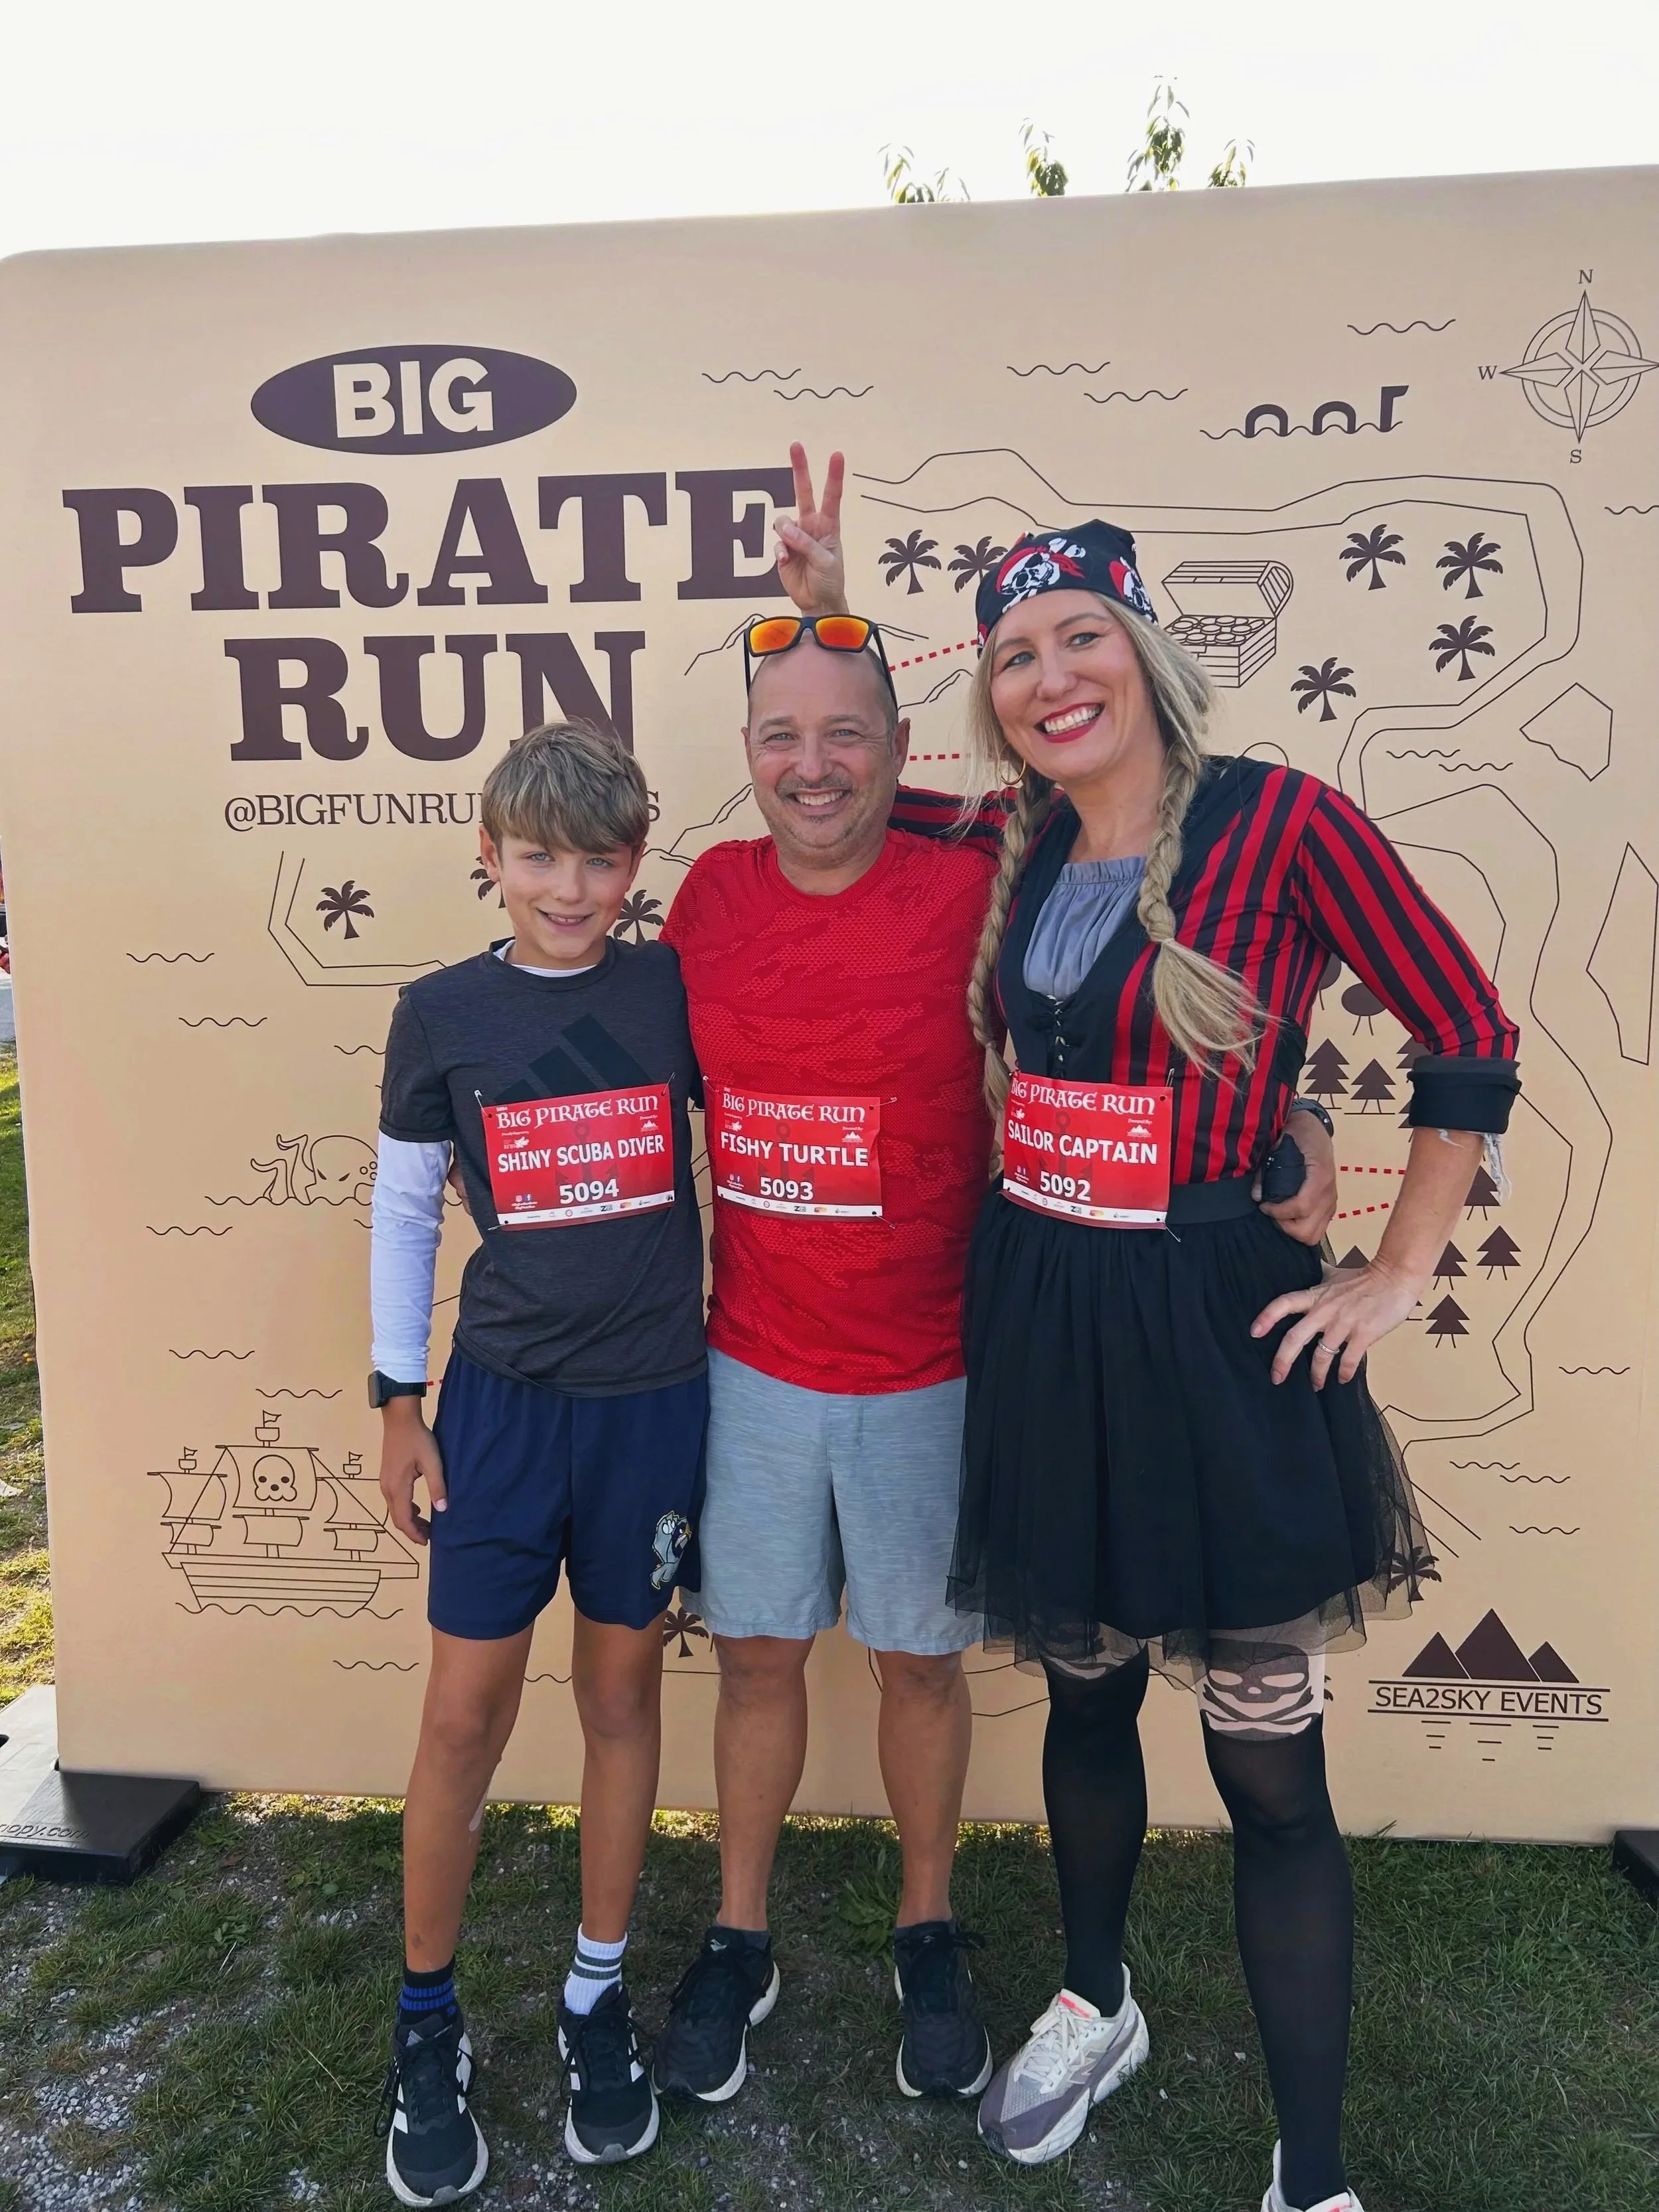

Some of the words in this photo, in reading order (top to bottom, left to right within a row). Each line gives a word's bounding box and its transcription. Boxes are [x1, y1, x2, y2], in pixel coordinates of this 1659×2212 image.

[1578, 269, 1594, 284] N
[1478, 365, 1498, 380] W
[332, 357, 494, 438] BIG
[1569, 449, 1583, 464] S
[62, 467, 796, 614] PIRATE
[224, 630, 646, 762] RUN
[496, 1108, 532, 1129] BIG
[534, 1098, 613, 1129] PIRATE
[615, 1095, 658, 1116] RUN
[722, 1092, 745, 1112] BIG
[746, 1098, 814, 1121] PIRATE
[818, 1104, 865, 1123] RUN
[1011, 1077, 1029, 1099] BIG
[1028, 1085, 1097, 1112] PIRATE
[1101, 1094, 1155, 1116] RUN
[497, 1148, 552, 1173] SHINY
[556, 1140, 614, 1167] SCUBA
[618, 1134, 666, 1159] DIVER
[720, 1131, 774, 1160] FISHY
[778, 1142, 869, 1167] TURTLE
[1007, 1119, 1055, 1153] SAILOR
[1058, 1136, 1157, 1165] CAPTAIN
[559, 1179, 620, 1205] 5094
[760, 1177, 814, 1201] 5093
[1039, 1170, 1091, 1202] 5092
[1376, 1686, 1491, 1711] SEA2SKY
[1500, 1691, 1603, 1715] EVENTS
